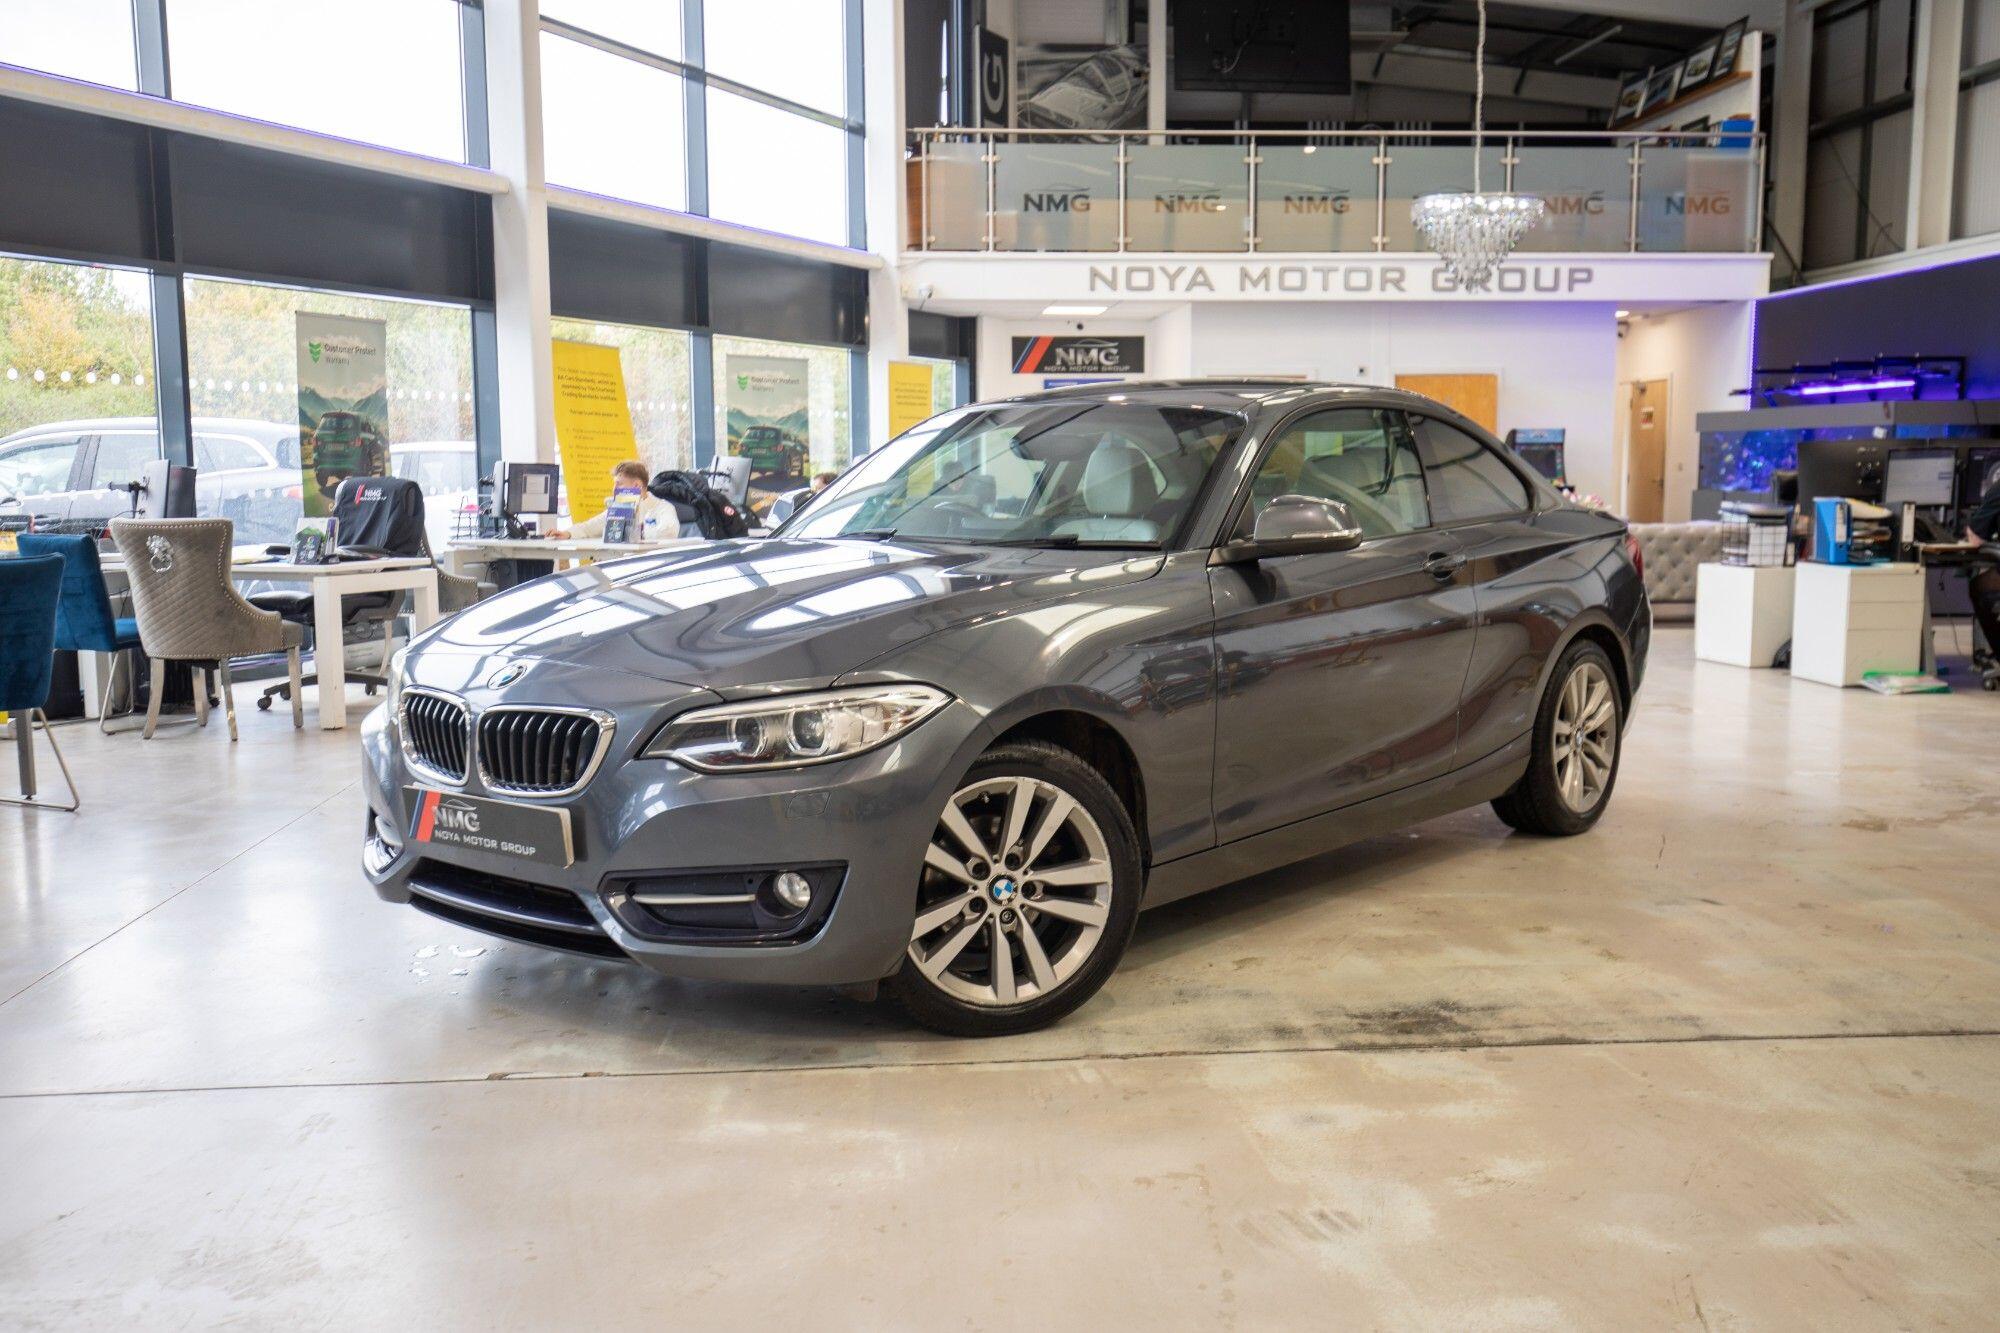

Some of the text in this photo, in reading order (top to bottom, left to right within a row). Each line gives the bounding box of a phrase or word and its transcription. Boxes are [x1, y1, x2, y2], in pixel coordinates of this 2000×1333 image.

[1023, 192, 1091, 212] NMG
[1155, 194, 1223, 213] NMG
[1284, 195, 1350, 214] NMG
[1665, 196, 1730, 215] NMG
[1088, 265, 1215, 292] NOYA
[1239, 265, 1407, 292] MOTOR
[1054, 347, 1120, 366] NMG
[431, 805, 481, 832] NMG
[434, 830, 536, 856] NOYA MOTOR GROUP
